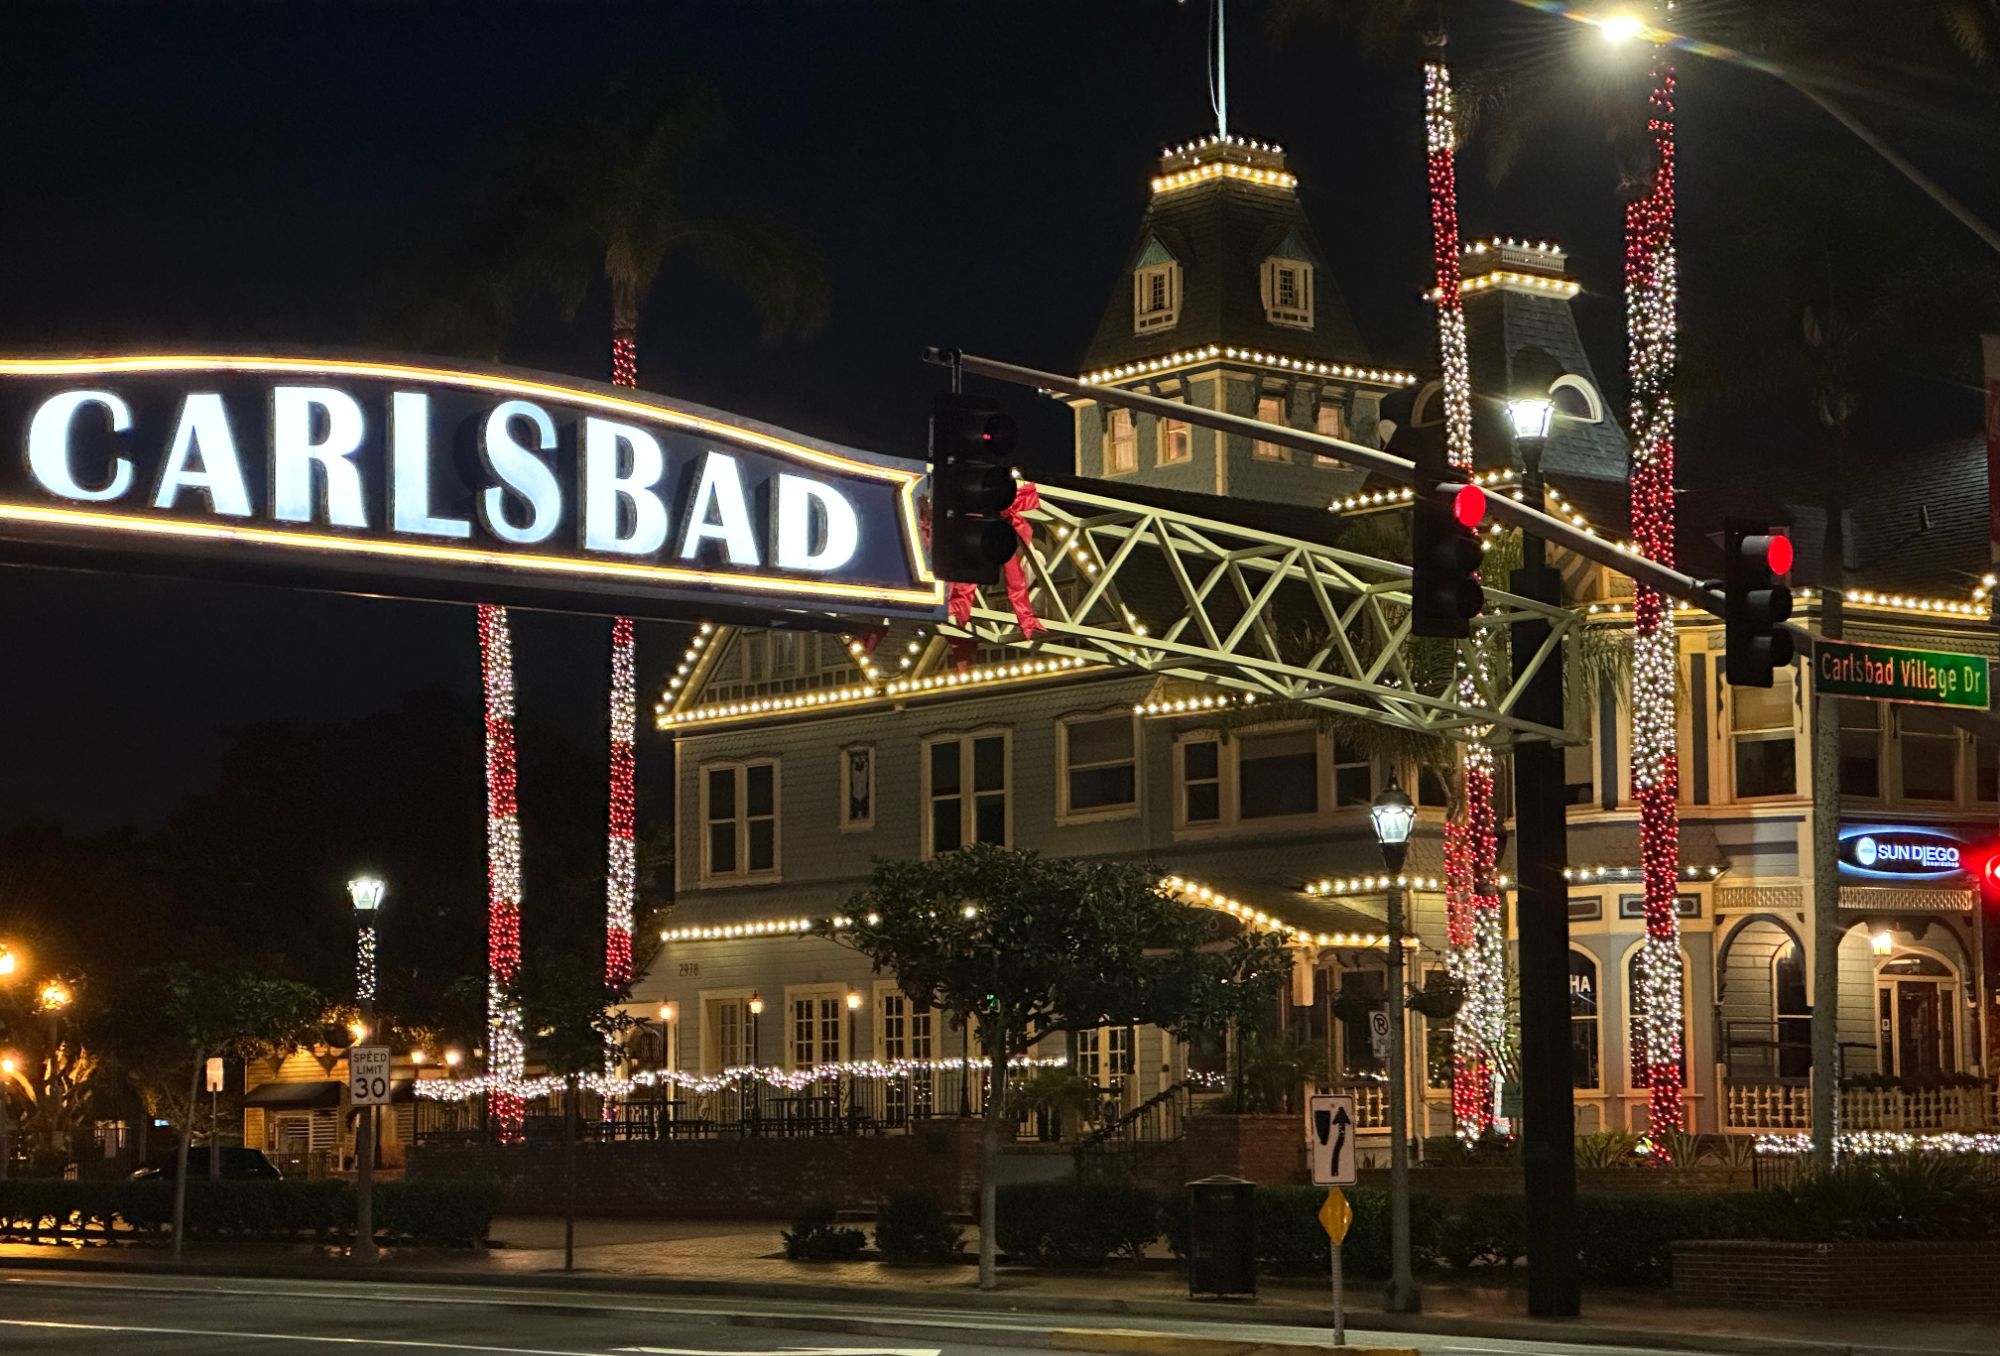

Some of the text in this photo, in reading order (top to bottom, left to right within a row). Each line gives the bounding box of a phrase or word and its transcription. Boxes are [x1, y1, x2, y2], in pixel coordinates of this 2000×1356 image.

[27, 385, 861, 571] CARLSBAD
[1821, 652, 1981, 698] Carlsbad Village Dr
[1878, 845, 1960, 866] SUN DIEGO
[353, 1053, 387, 1063] SPEED
[357, 1065, 383, 1075] LIMIT
[355, 1077, 386, 1098] 30
